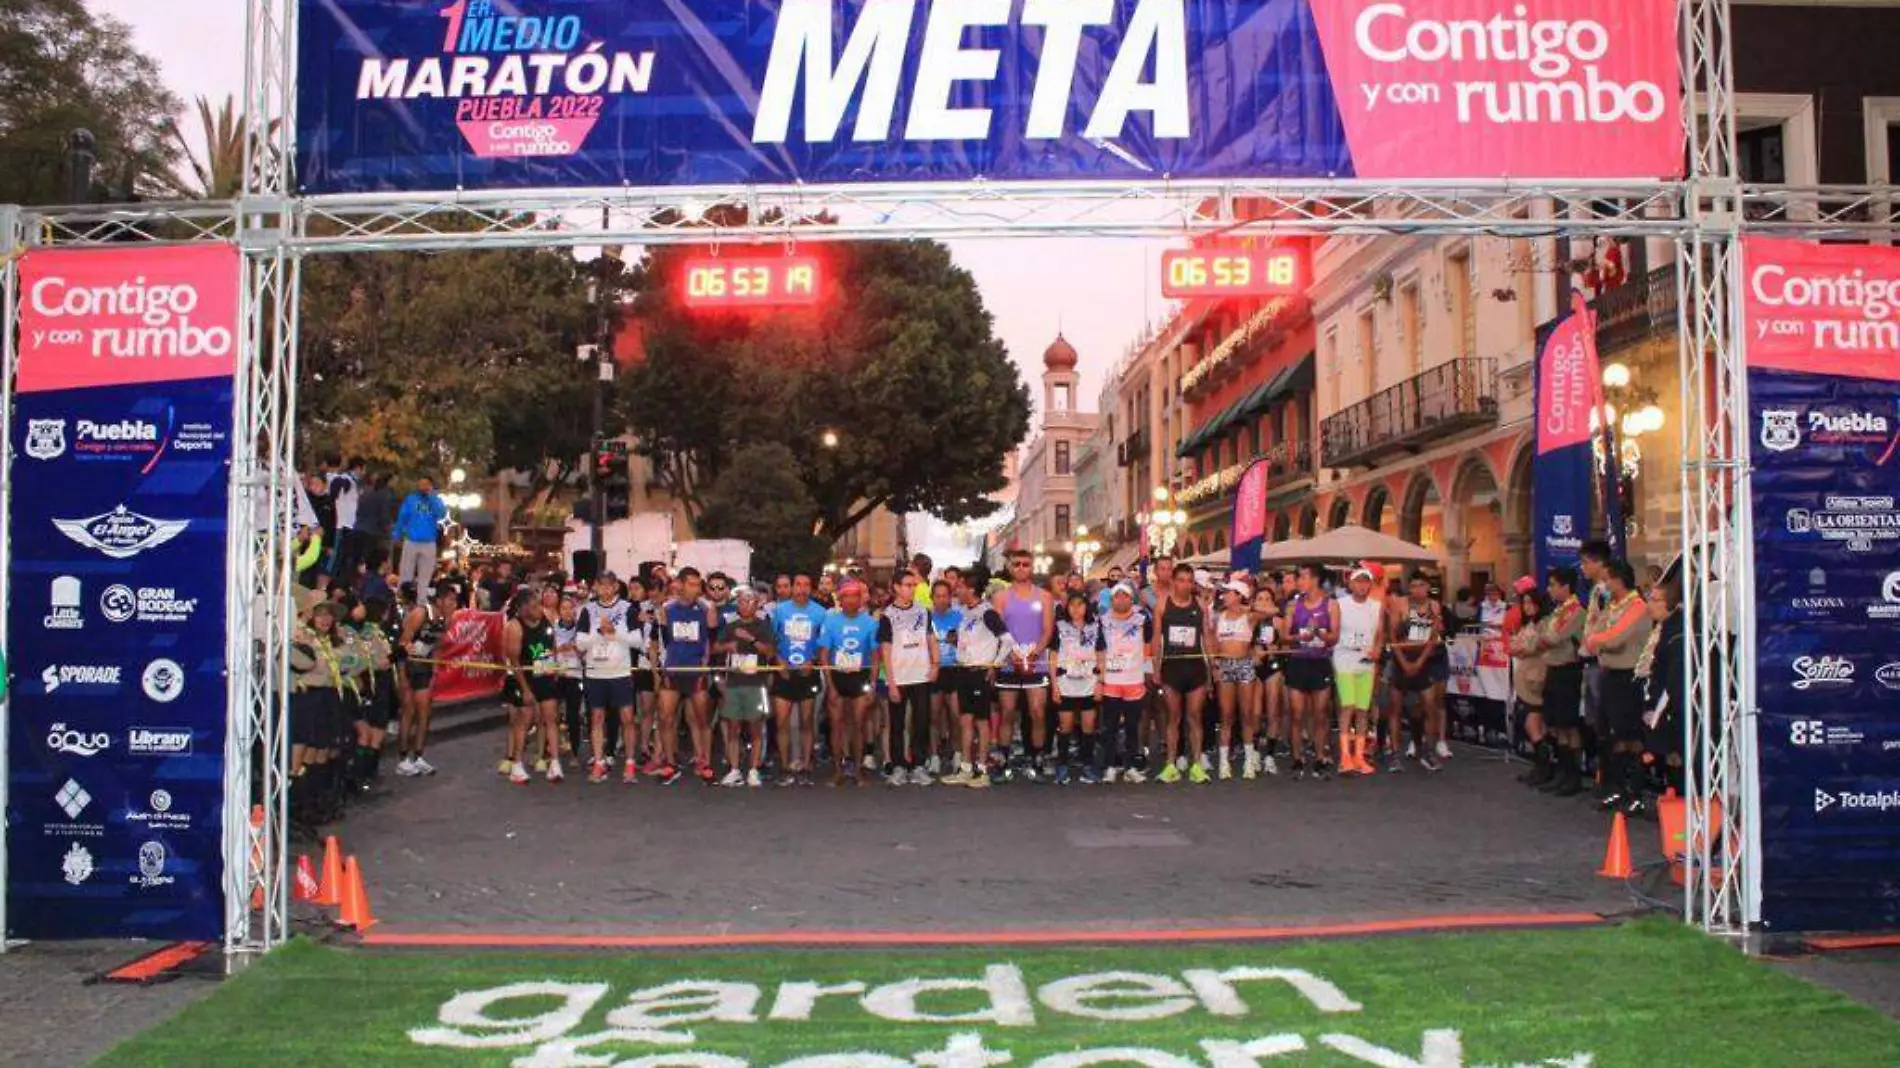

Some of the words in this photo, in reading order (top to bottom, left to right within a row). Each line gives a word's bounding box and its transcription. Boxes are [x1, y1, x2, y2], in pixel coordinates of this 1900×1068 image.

[459, 15, 580, 52] MEDIO
[1355, 3, 1609, 78] Contigo
[356, 42, 655, 98] MARATÓN
[751, 0, 1190, 143] META
[456, 97, 541, 120] PUEBLA
[547, 95, 603, 118] 2022
[1361, 83, 1381, 111] y
[1387, 82, 1440, 104] con
[1455, 64, 1665, 123] rumbo
[689, 266, 726, 297] 06
[732, 266, 770, 296] 53
[1170, 257, 1207, 287] 06
[1212, 257, 1250, 286] 53
[1267, 256, 1294, 285] 18
[31, 276, 197, 325] Contigo
[33, 329, 46, 348] y
[48, 329, 83, 344] con
[91, 316, 232, 357] rumbo
[1756, 319, 1768, 338] y
[1771, 320, 1804, 335] con
[76, 419, 157, 440] Puebla
[1808, 412, 1887, 432] Puebla
[173, 440, 213, 451] Deporte
[1817, 514, 1835, 527] LA
[137, 588, 175, 600] GRAN
[60, 665, 122, 683] SPORADE
[406, 963, 1362, 1047] garden
